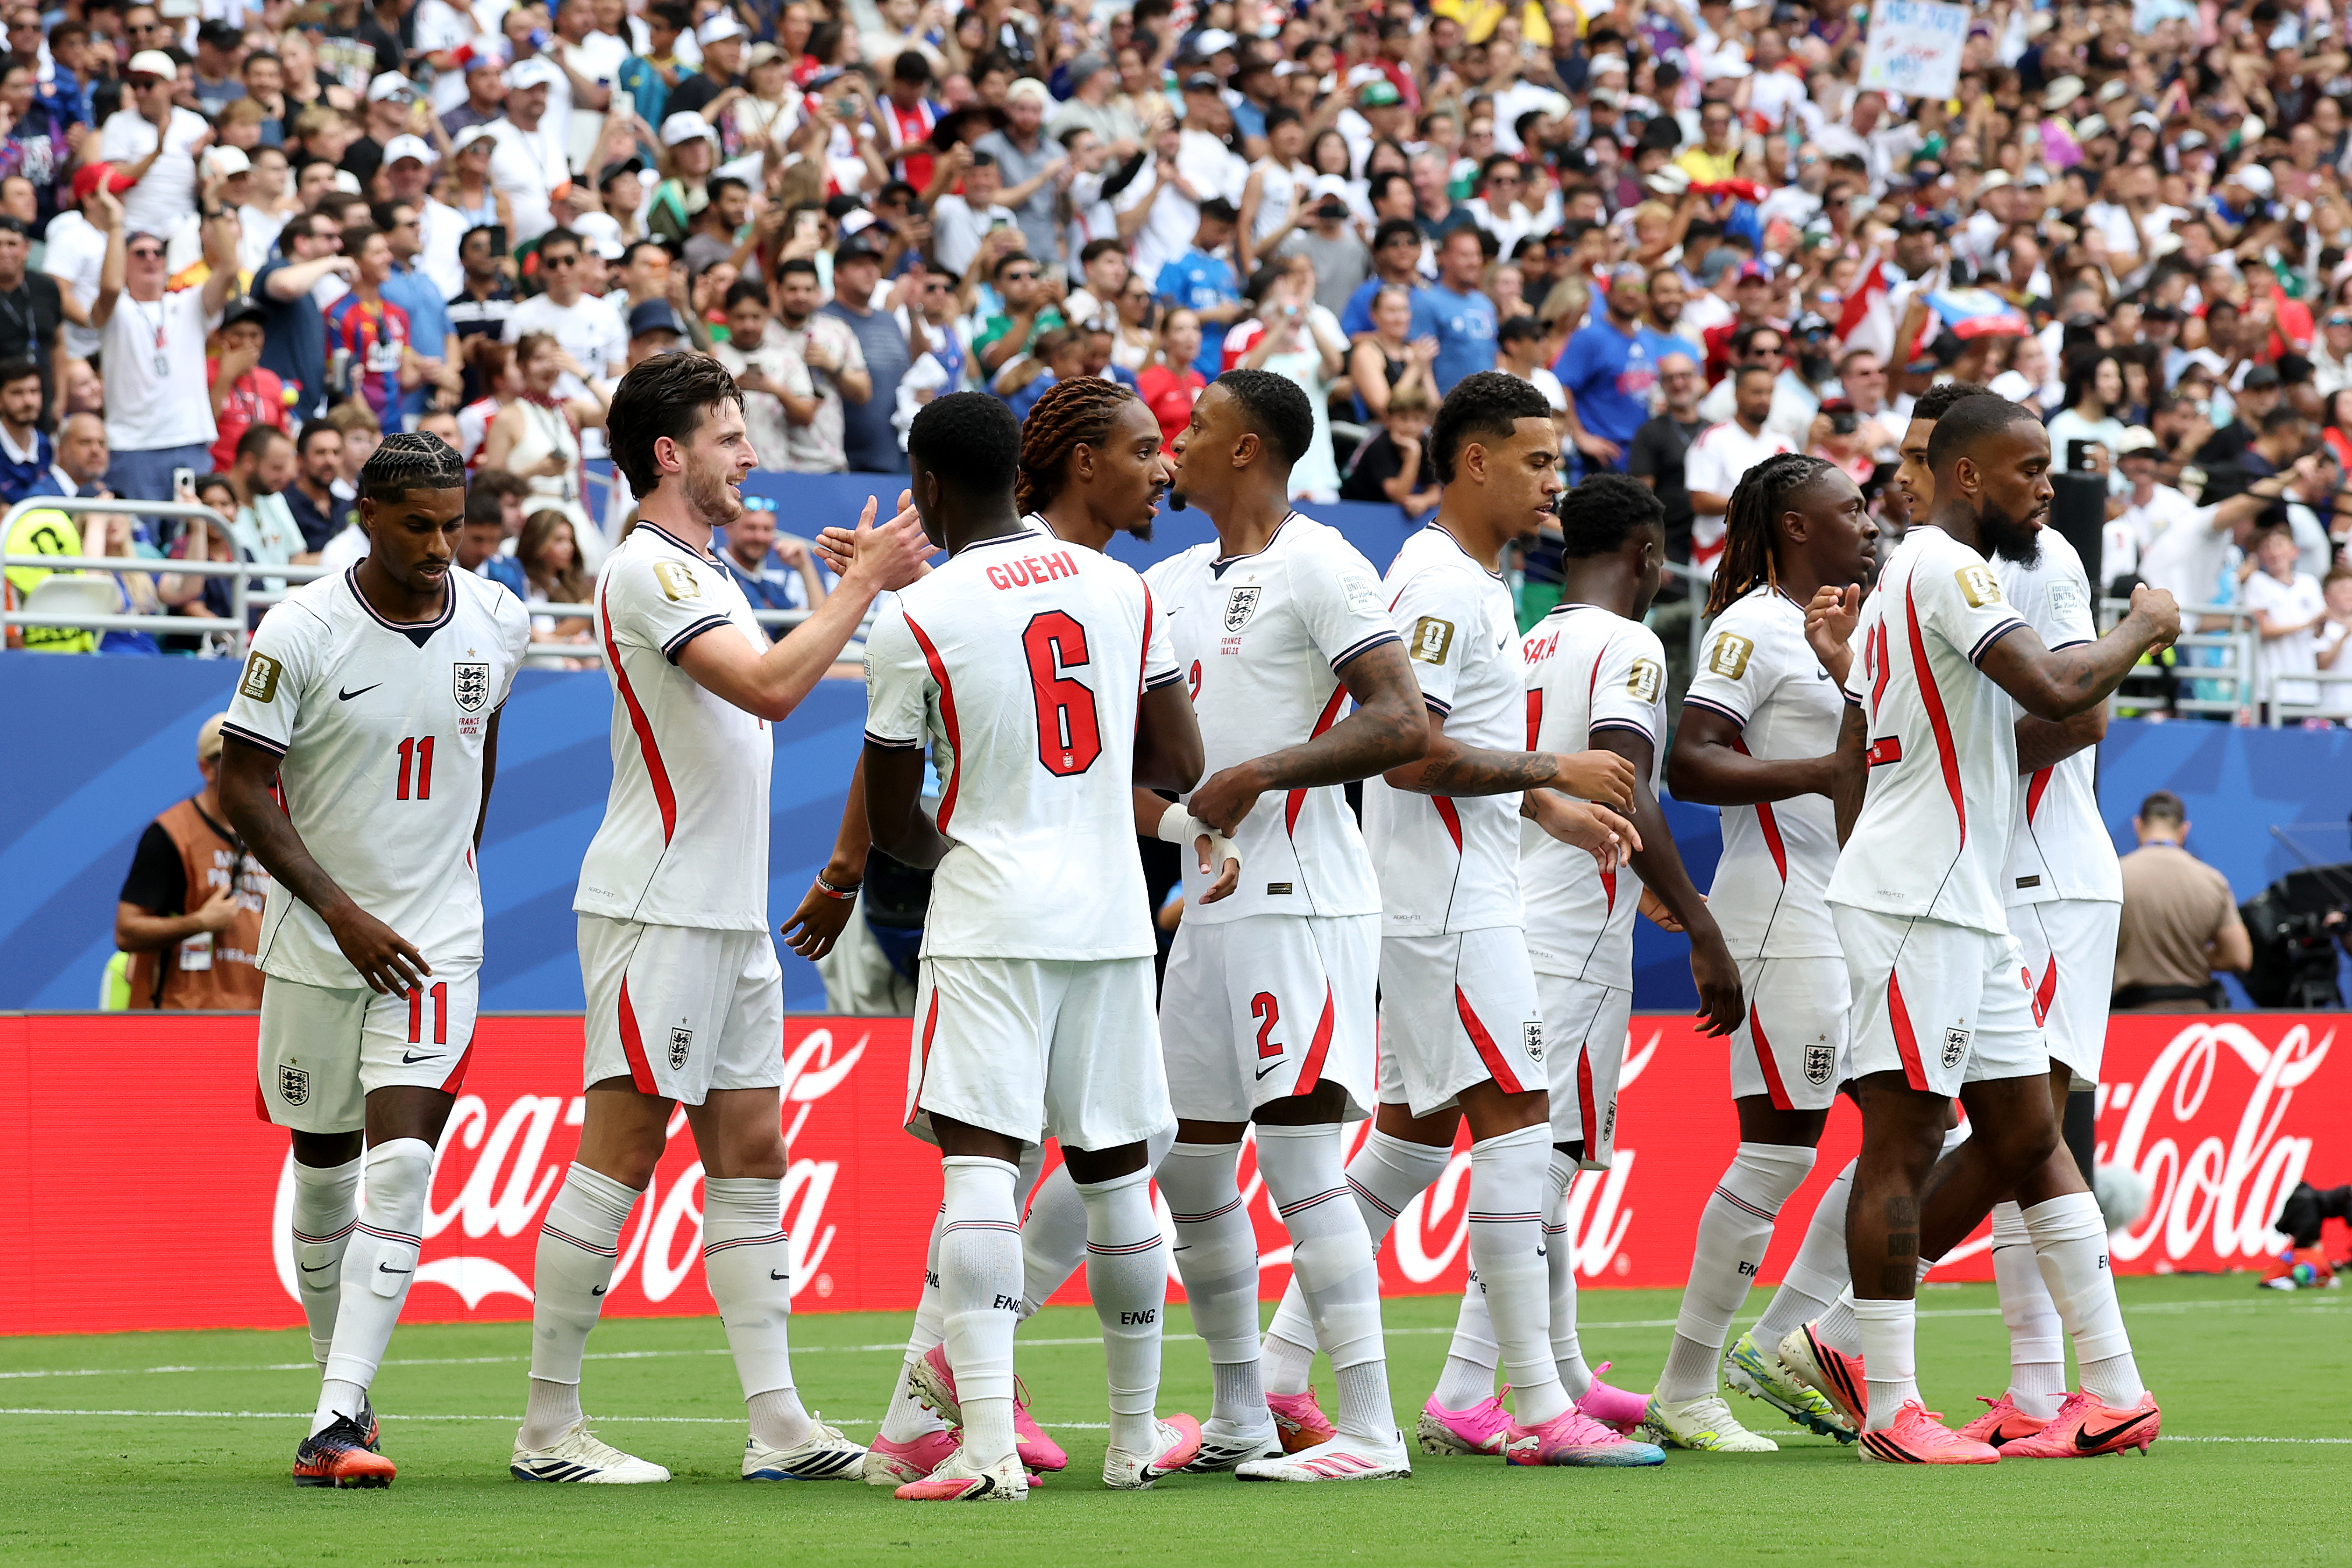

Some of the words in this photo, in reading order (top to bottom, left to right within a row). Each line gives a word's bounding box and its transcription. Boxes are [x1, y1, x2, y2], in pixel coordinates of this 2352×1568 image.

[987, 551, 1079, 591] GUÉHI
[2053, 592, 2076, 601] UNITES
[1221, 637, 1241, 645] FRANCE
[244, 688, 263, 698] 2026
[1021, 609, 1102, 777] 6
[459, 717, 480, 725] FRANCE
[397, 736, 435, 800] 11
[407, 981, 447, 1045] 11
[1250, 991, 1283, 1060] 2
[1738, 1261, 1758, 1278] EN
[2099, 1255, 2110, 1269] EN
[994, 1294, 1021, 1314] ENG
[1120, 1308, 1155, 1325] ENG
